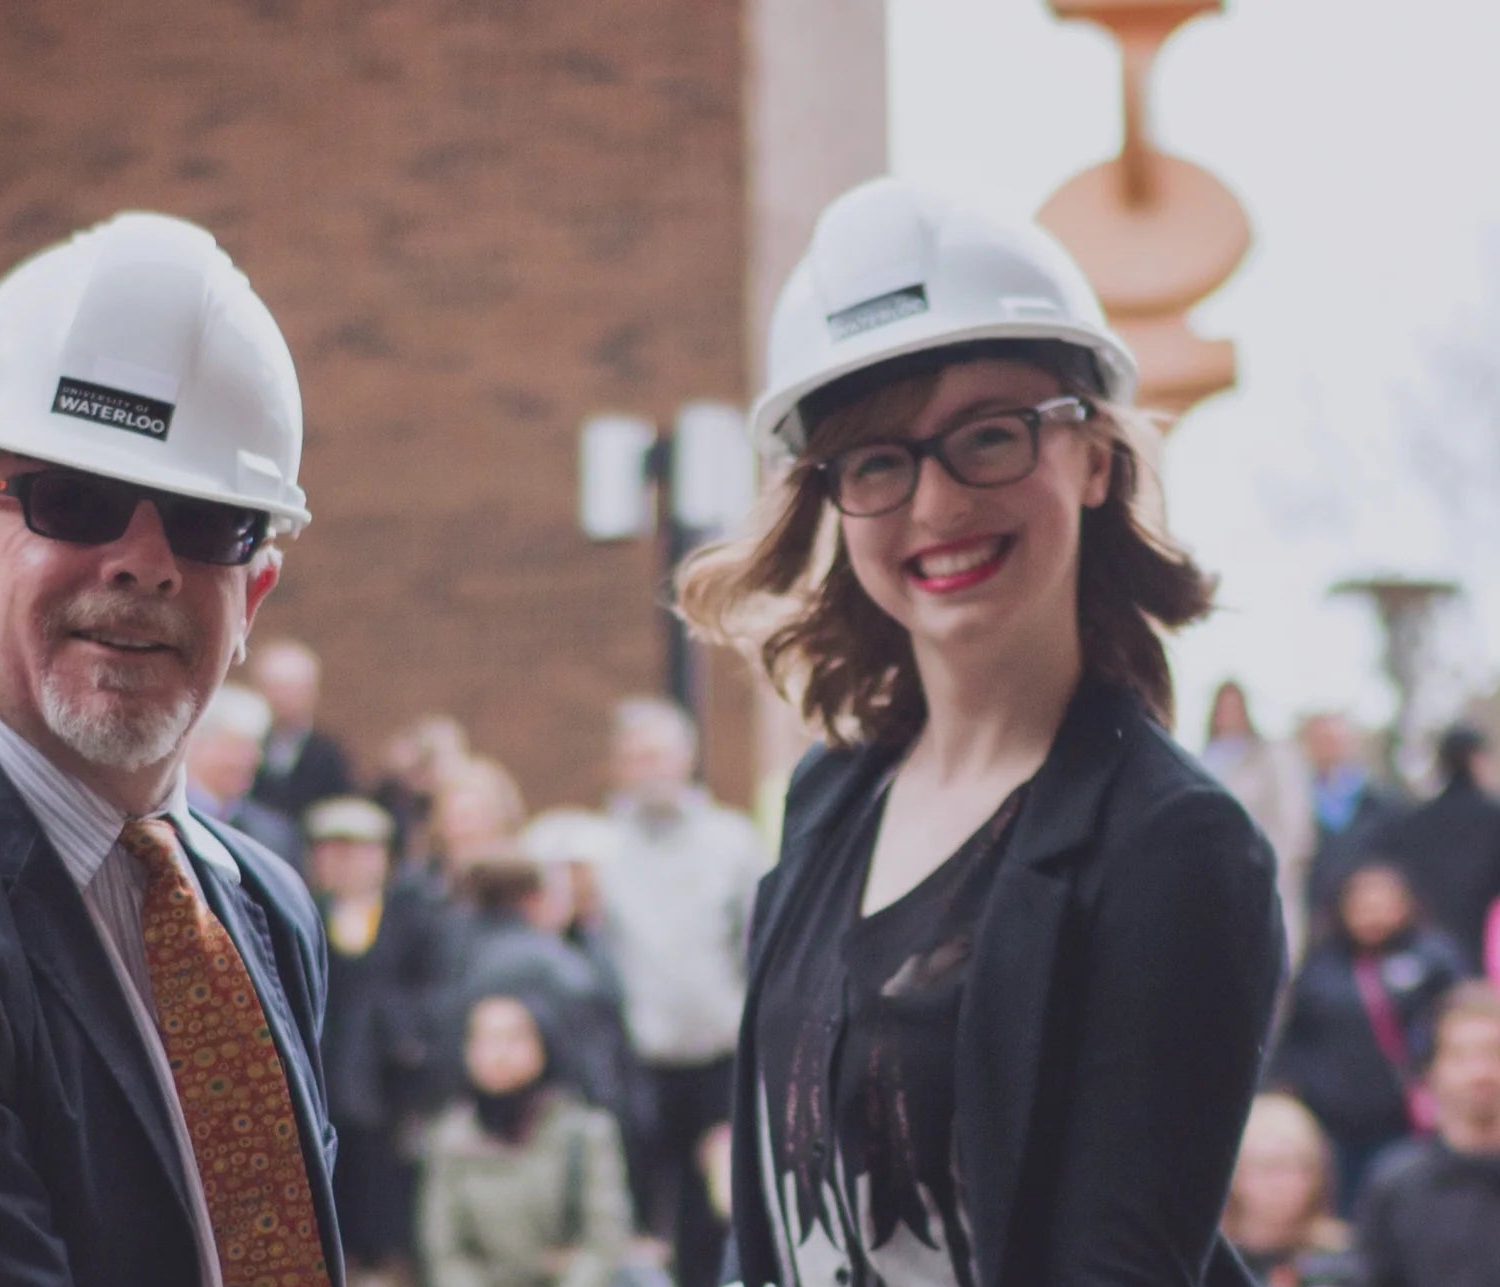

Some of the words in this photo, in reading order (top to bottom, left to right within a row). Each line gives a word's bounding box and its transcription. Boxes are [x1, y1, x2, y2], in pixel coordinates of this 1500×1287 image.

[59, 394, 166, 434] WATERLOO
[62, 386, 131, 409] UNIVERSITY
[135, 404, 150, 413] OF
